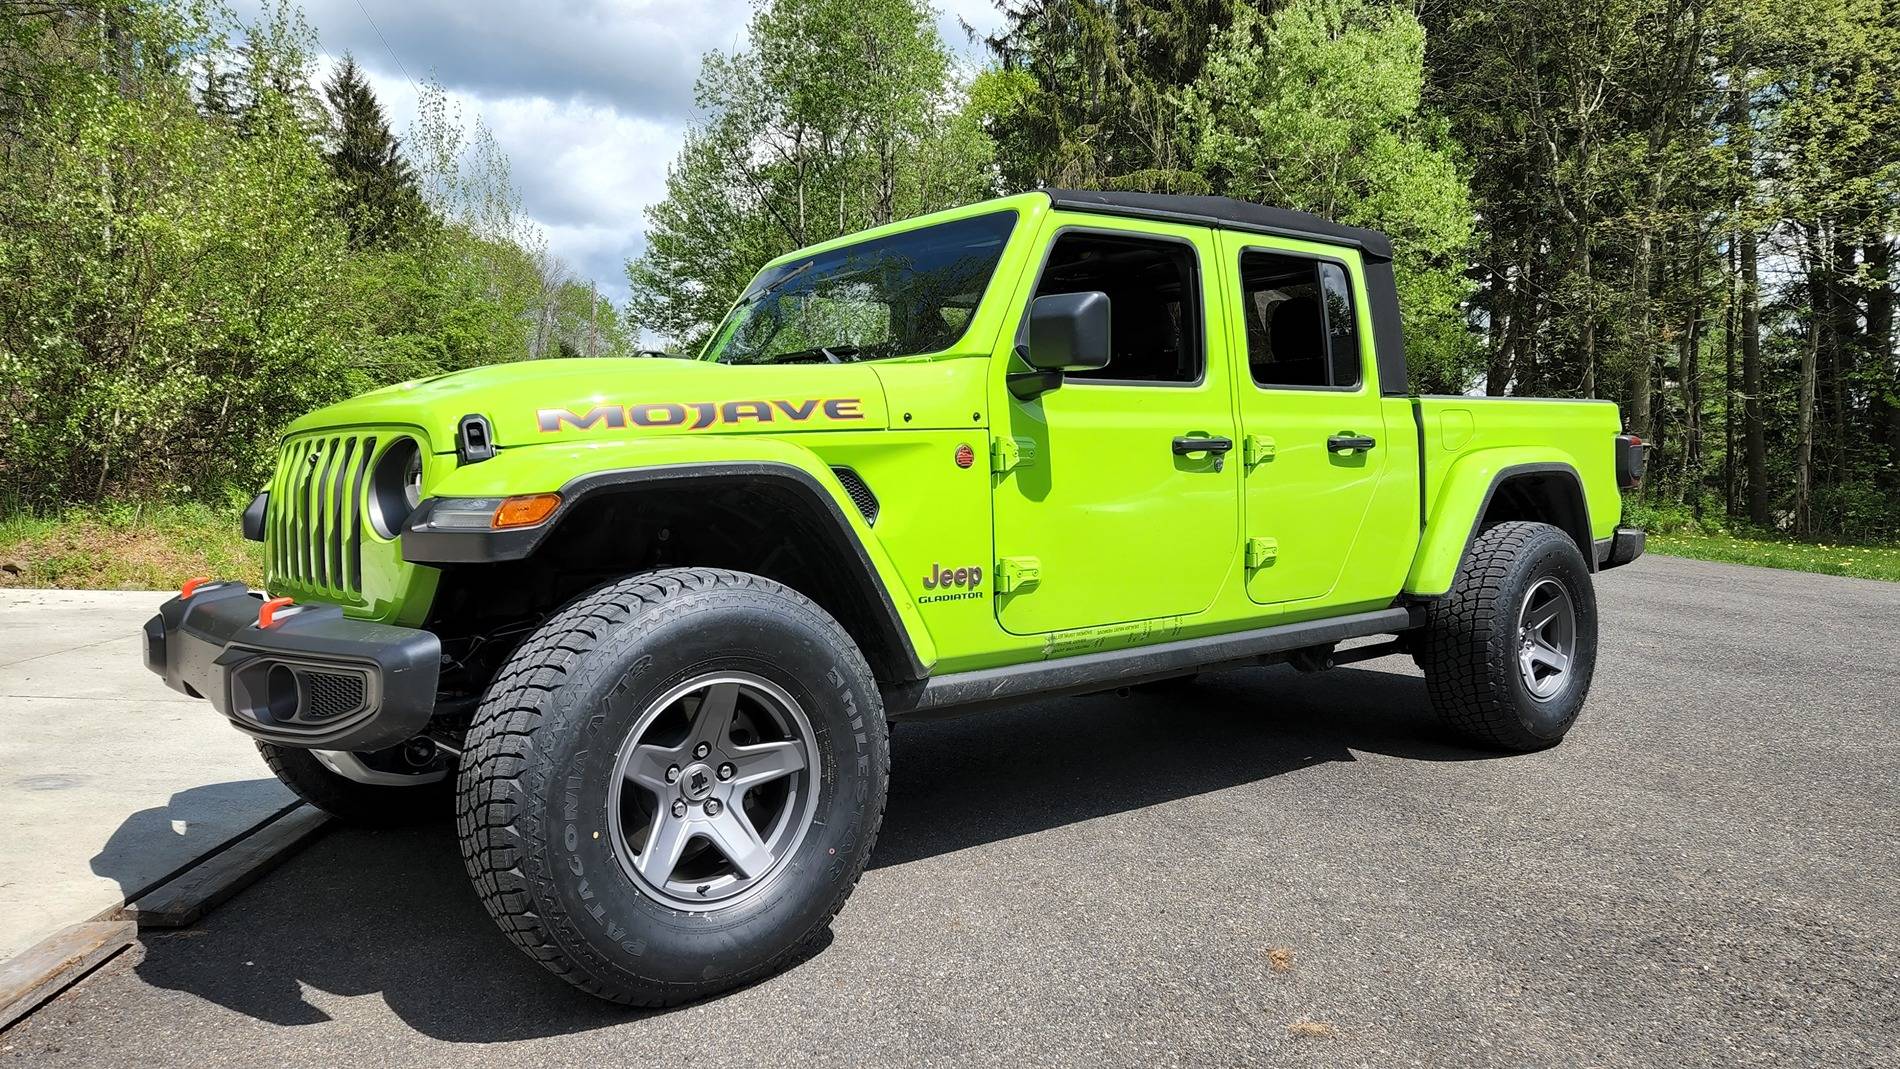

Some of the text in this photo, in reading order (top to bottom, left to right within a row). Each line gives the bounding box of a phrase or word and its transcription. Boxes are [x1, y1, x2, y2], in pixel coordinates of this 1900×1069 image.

[535, 399, 864, 432] MOJAVE
[922, 563, 982, 591] Jeep
[918, 591, 983, 604] GLADIATOR
[564, 750, 647, 957] PATAGONIA
